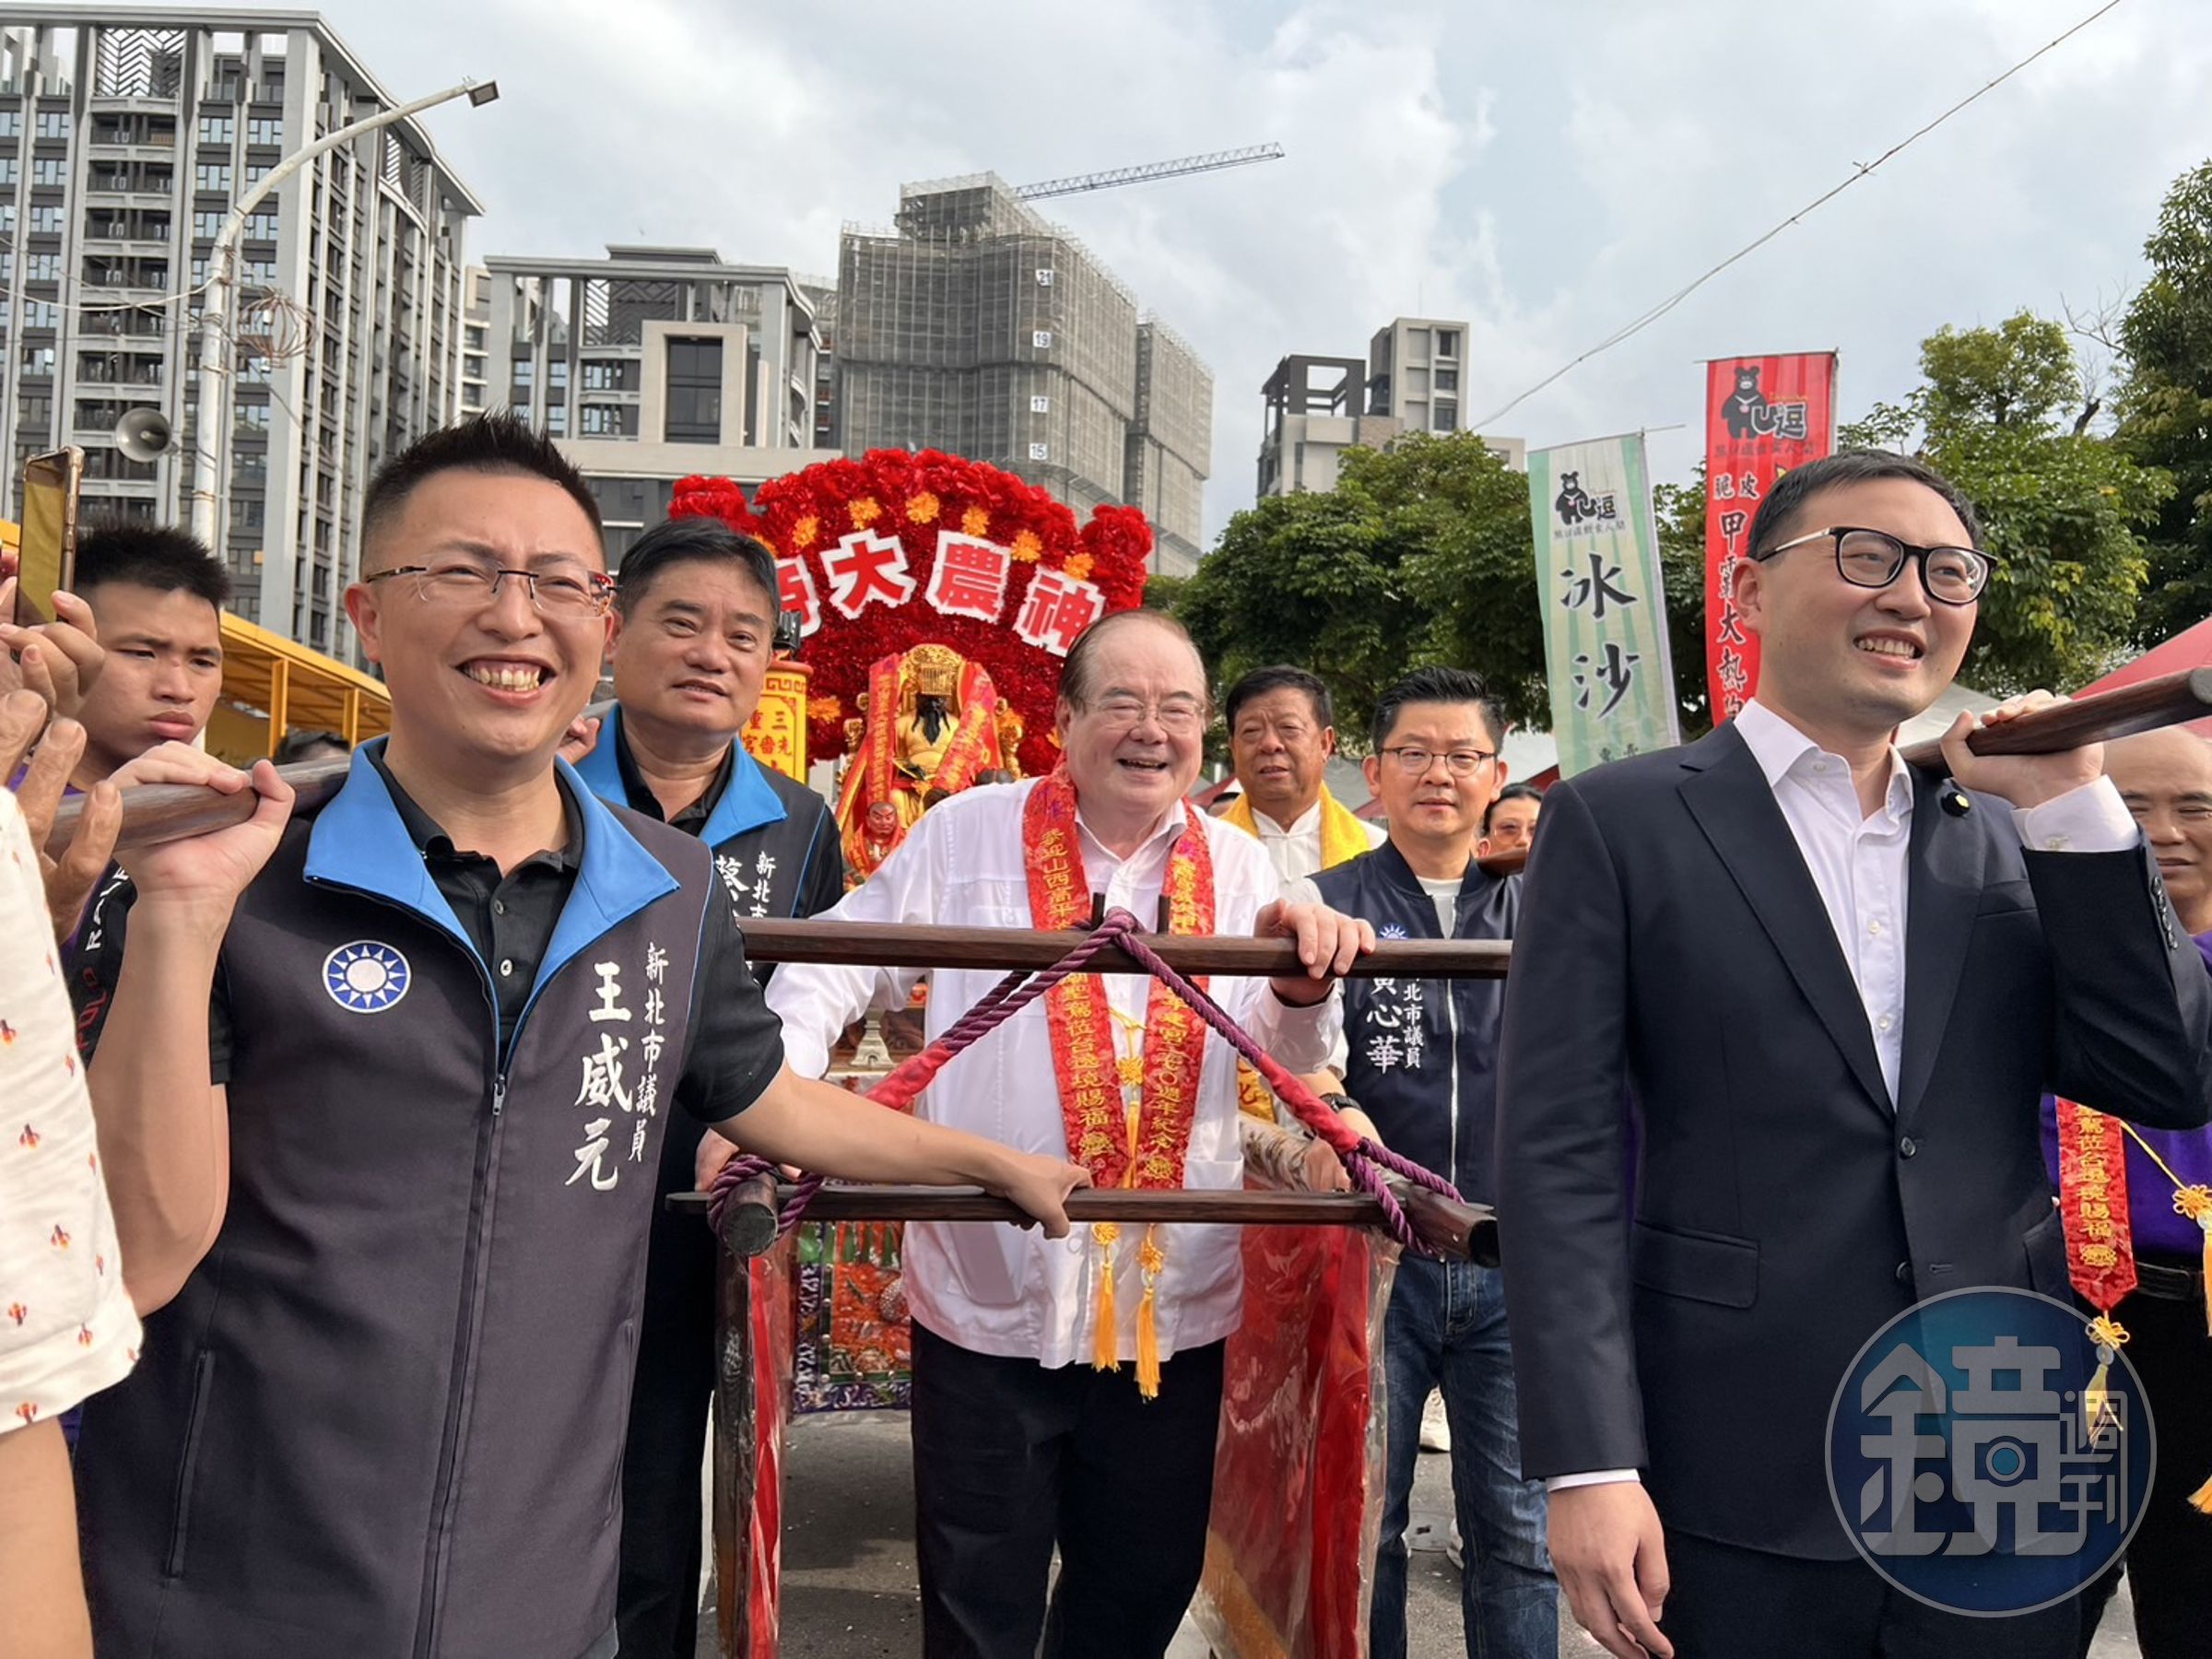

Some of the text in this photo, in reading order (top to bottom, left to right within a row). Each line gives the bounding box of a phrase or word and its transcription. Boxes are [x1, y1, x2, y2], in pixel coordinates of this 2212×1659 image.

[1035, 333, 1049, 347] 19
[1032, 396, 1047, 411] 17
[1031, 443, 1046, 459] 15
[1559, 552, 1639, 719] 冰沙
[628, 941, 669, 1163] 新北市議員
[1403, 978, 1424, 1069] 北市議員
[565, 960, 633, 1192] 王威元
